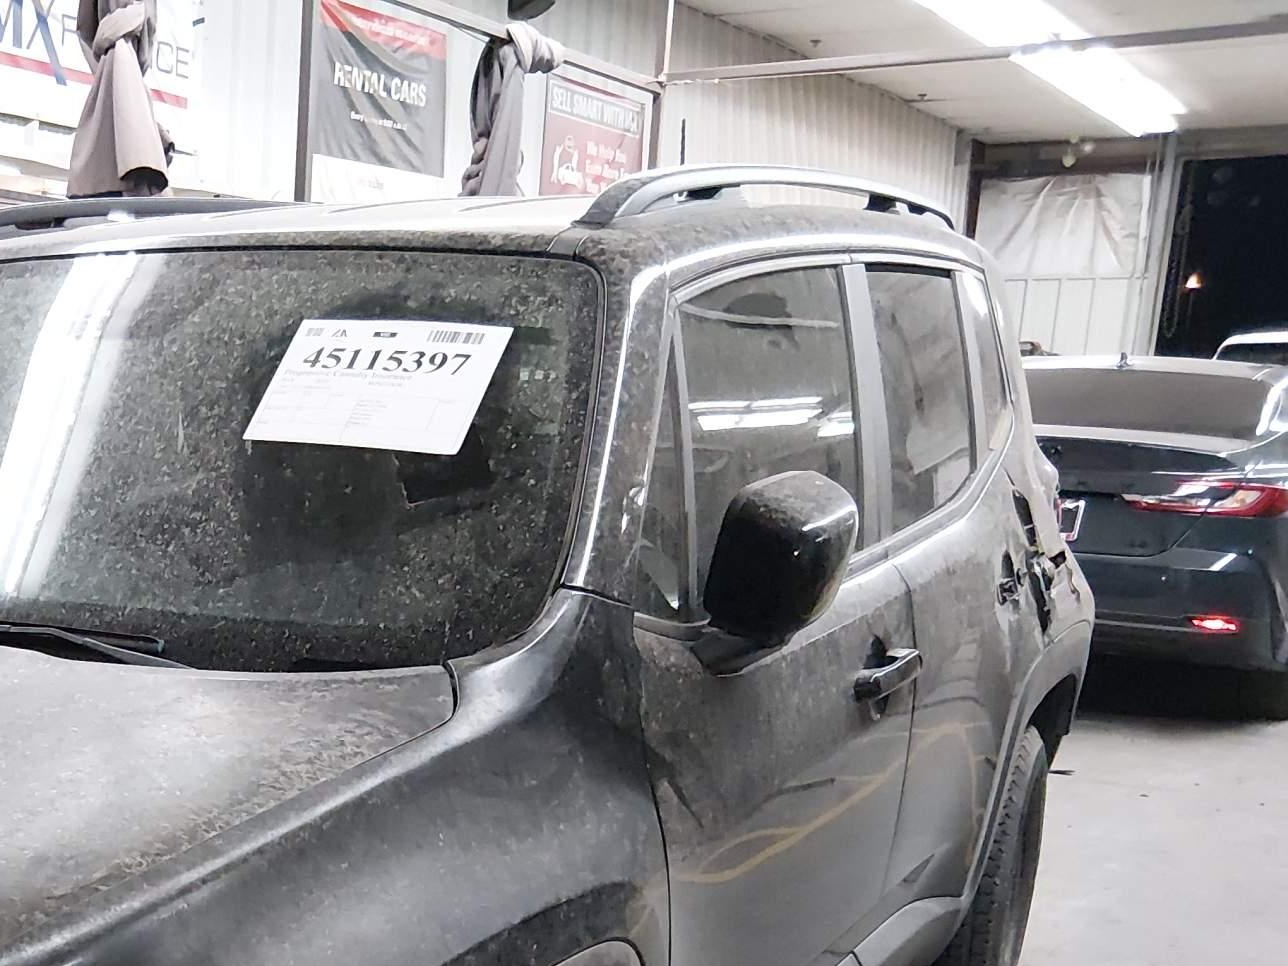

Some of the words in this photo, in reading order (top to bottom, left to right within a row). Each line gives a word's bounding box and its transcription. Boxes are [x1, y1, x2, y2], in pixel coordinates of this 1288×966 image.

[334, 61, 388, 98] RENTAL
[391, 77, 427, 107] CARS
[552, 86, 571, 112] SELL
[303, 346, 472, 376] 45115397
